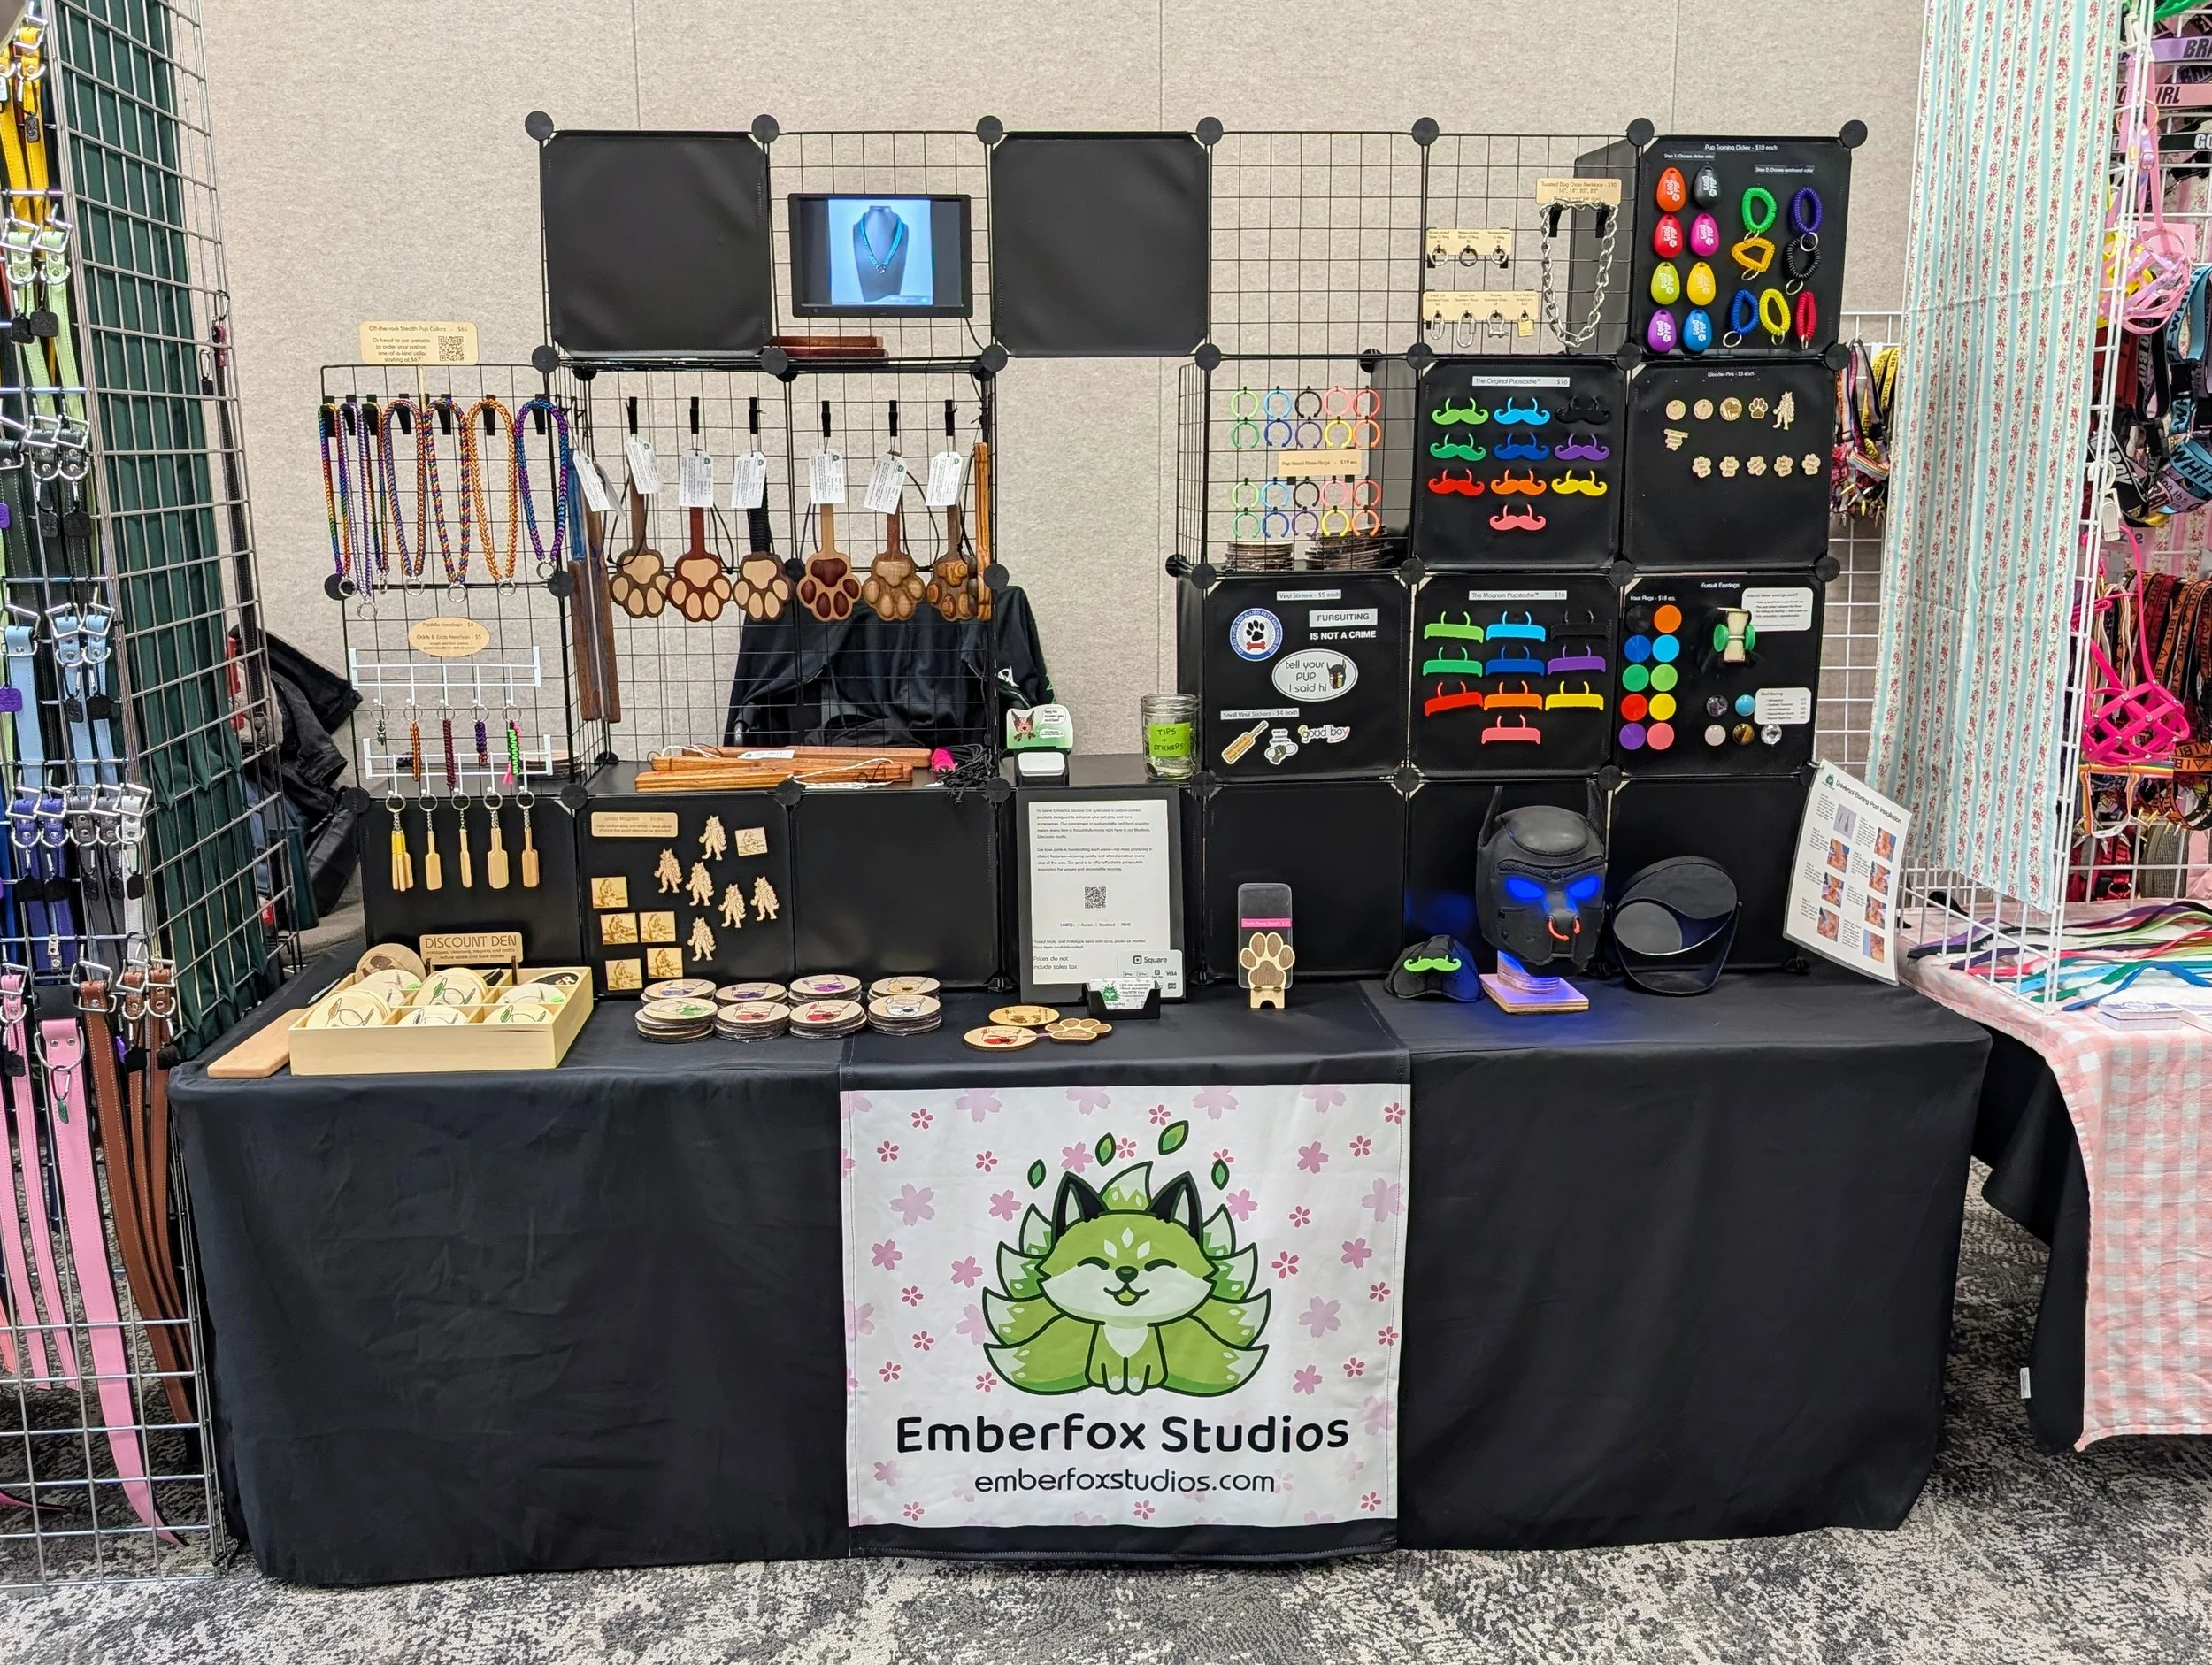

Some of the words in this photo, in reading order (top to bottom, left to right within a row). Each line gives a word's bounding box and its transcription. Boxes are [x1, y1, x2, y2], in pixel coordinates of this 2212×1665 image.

[2154, 86, 2180, 104] IRL
[1317, 613, 1370, 622] FURSUITING
[1348, 630, 1377, 639] CRIME
[1286, 660, 1300, 669] tell
[1302, 661, 1325, 670] your
[1296, 672, 1316, 681] PUP
[1294, 683, 1316, 692] said
[1318, 683, 1327, 692] hi
[1302, 727, 1327, 742] good
[1330, 725, 1349, 741] boy
[1836, 779, 1855, 795] Universal
[1855, 791, 1870, 805] Earring
[1870, 800, 1880, 810] Post
[1879, 806, 1902, 824] Installation
[426, 936, 487, 948] DISCOUNT
[492, 935, 517, 947] DEN
[897, 1413, 1146, 1453] Emberfox
[1161, 1416, 1349, 1453] Studios
[975, 1467, 1275, 1492] emberfoxstudios.com
